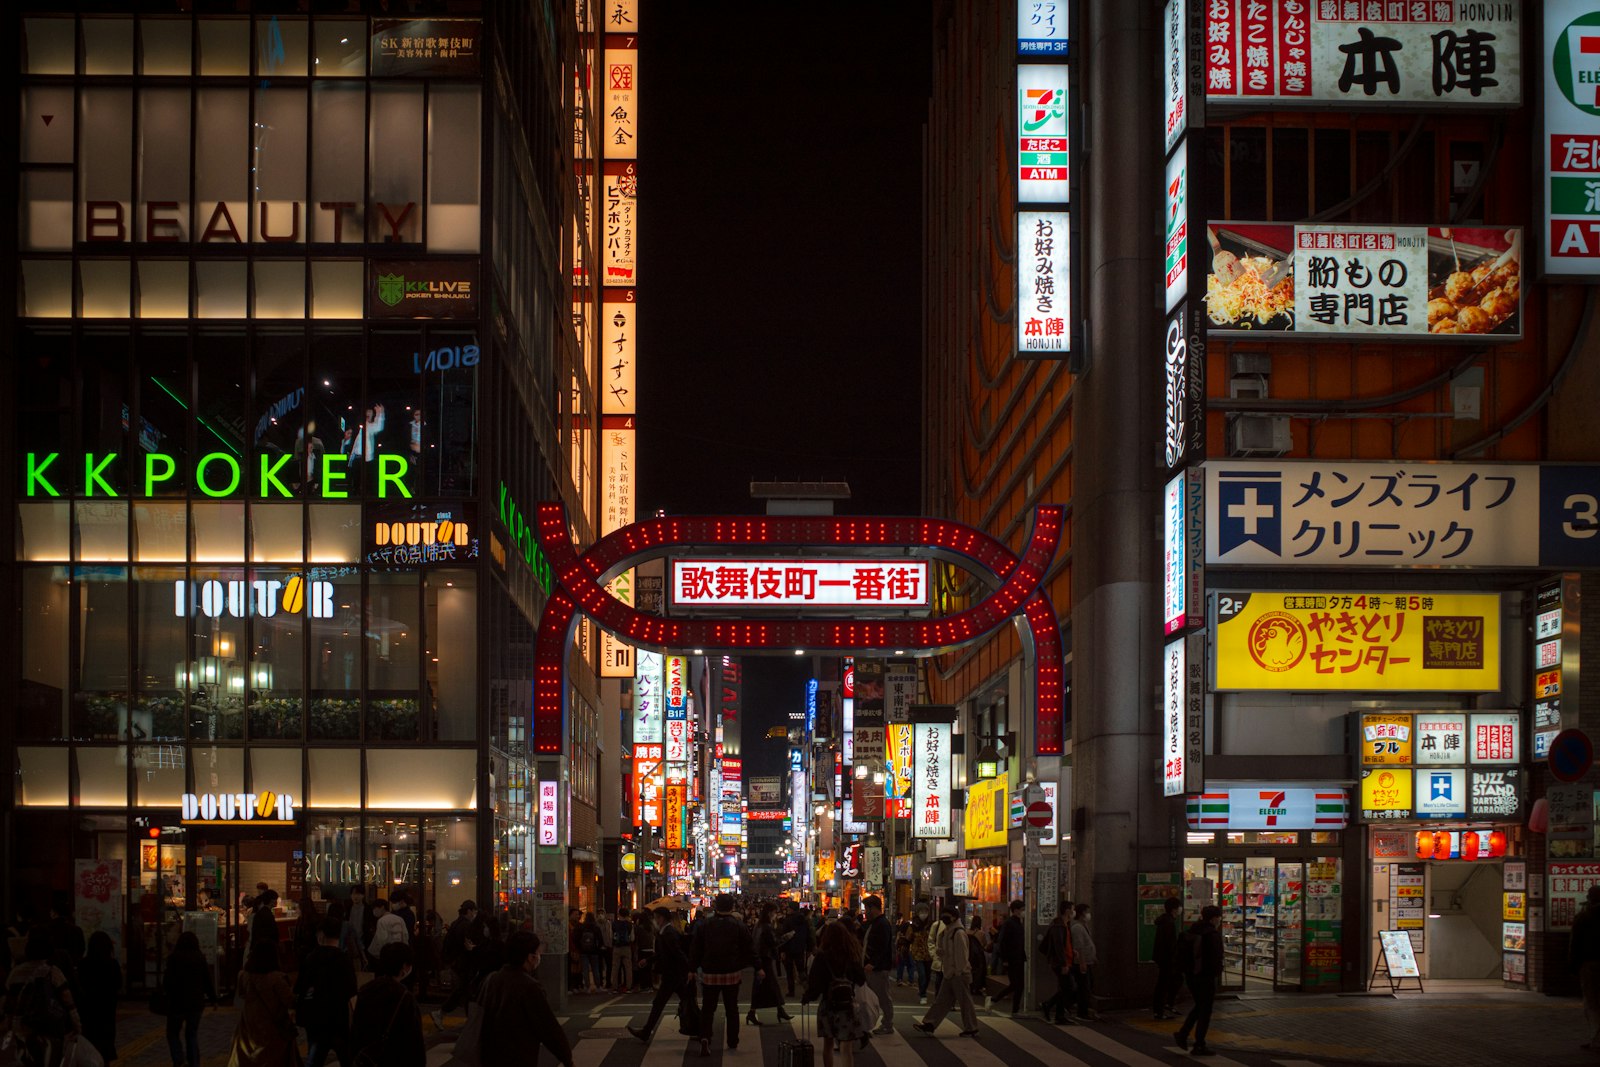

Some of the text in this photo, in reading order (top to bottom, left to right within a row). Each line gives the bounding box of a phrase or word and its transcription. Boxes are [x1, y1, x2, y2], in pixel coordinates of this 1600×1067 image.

[1046, 2, 1056, 37] ライフ
[1319, 2, 1513, 21] 歌舞伎町名物 HONJIN
[381, 37, 473, 49] SK 新宿歌舞伎町
[626, 38, 634, 48] 7
[1020, 42, 1067, 51] 男性専門 3F
[1246, 2, 1268, 89] たこ焼き
[1283, 1, 1306, 91] もんじゃ焼き
[1338, 28, 1499, 97] 本陣
[611, 106, 633, 145] 魚金
[1027, 139, 1061, 151] たばこ
[1036, 154, 1051, 165] 酒
[626, 164, 634, 175] 6
[1029, 169, 1057, 179] ATM
[87, 201, 415, 243] BEAUTY
[608, 186, 620, 258] ビアポンバー
[624, 206, 632, 227] ダーツ
[624, 229, 632, 256] カラオケ
[1299, 233, 1425, 249] 歌舞伎町名物 HONJIN
[1034, 219, 1054, 313] お好み焼き
[1307, 256, 1408, 289] 粉もの
[406, 282, 471, 291] KKLIVE
[626, 291, 634, 302] 5
[1307, 293, 1408, 325] 専門店
[1024, 318, 1064, 337] 本陣
[1026, 338, 1062, 350] HONJIN
[610, 333, 629, 407] すずや
[624, 418, 633, 428] 4
[1191, 404, 1204, 450] スパークル
[27, 453, 412, 504] KKPOKER
[1292, 470, 1599, 539] メンズライフ 3
[376, 520, 469, 546] DOUTOR
[1190, 484, 1201, 571] ファイトフィット
[500, 480, 551, 599] KKPOKER
[1292, 520, 1474, 560] クリニック
[681, 566, 919, 600] 歌舞伎町一番街
[1219, 598, 1242, 614] 2F
[1284, 597, 1325, 609] 営業時間
[1307, 612, 1405, 643] やきとり
[1426, 620, 1480, 640] やきとり
[1310, 643, 1411, 674] センター
[1429, 641, 1477, 660] 専門店
[1538, 671, 1558, 687] 麻雀
[1544, 682, 1559, 694] ブル
[637, 675, 650, 724] バンタイ
[668, 710, 684, 718] B1F
[1190, 664, 1201, 764] 歌舞伎町名物
[1377, 725, 1398, 737] 麻雀
[900, 726, 910, 777] ハイボール
[1374, 742, 1399, 754] ブル
[1421, 734, 1460, 750] 本陣
[926, 728, 939, 790] お好み焼き
[1473, 773, 1504, 785] BUZZ
[1372, 789, 1399, 798] やきとり
[1473, 785, 1514, 797] STAND
[180, 791, 294, 825] DOUTOR
[926, 794, 939, 824] 本陣
[1373, 798, 1400, 807] センター
[1473, 806, 1508, 814] KARAOKE
[543, 787, 554, 843] 劇場通り
[898, 810, 910, 818] 2F
[1364, 809, 1410, 819] 朝まで営業中
[919, 827, 946, 836] HONJIN
[1307, 884, 1341, 894] たばこ 酒
